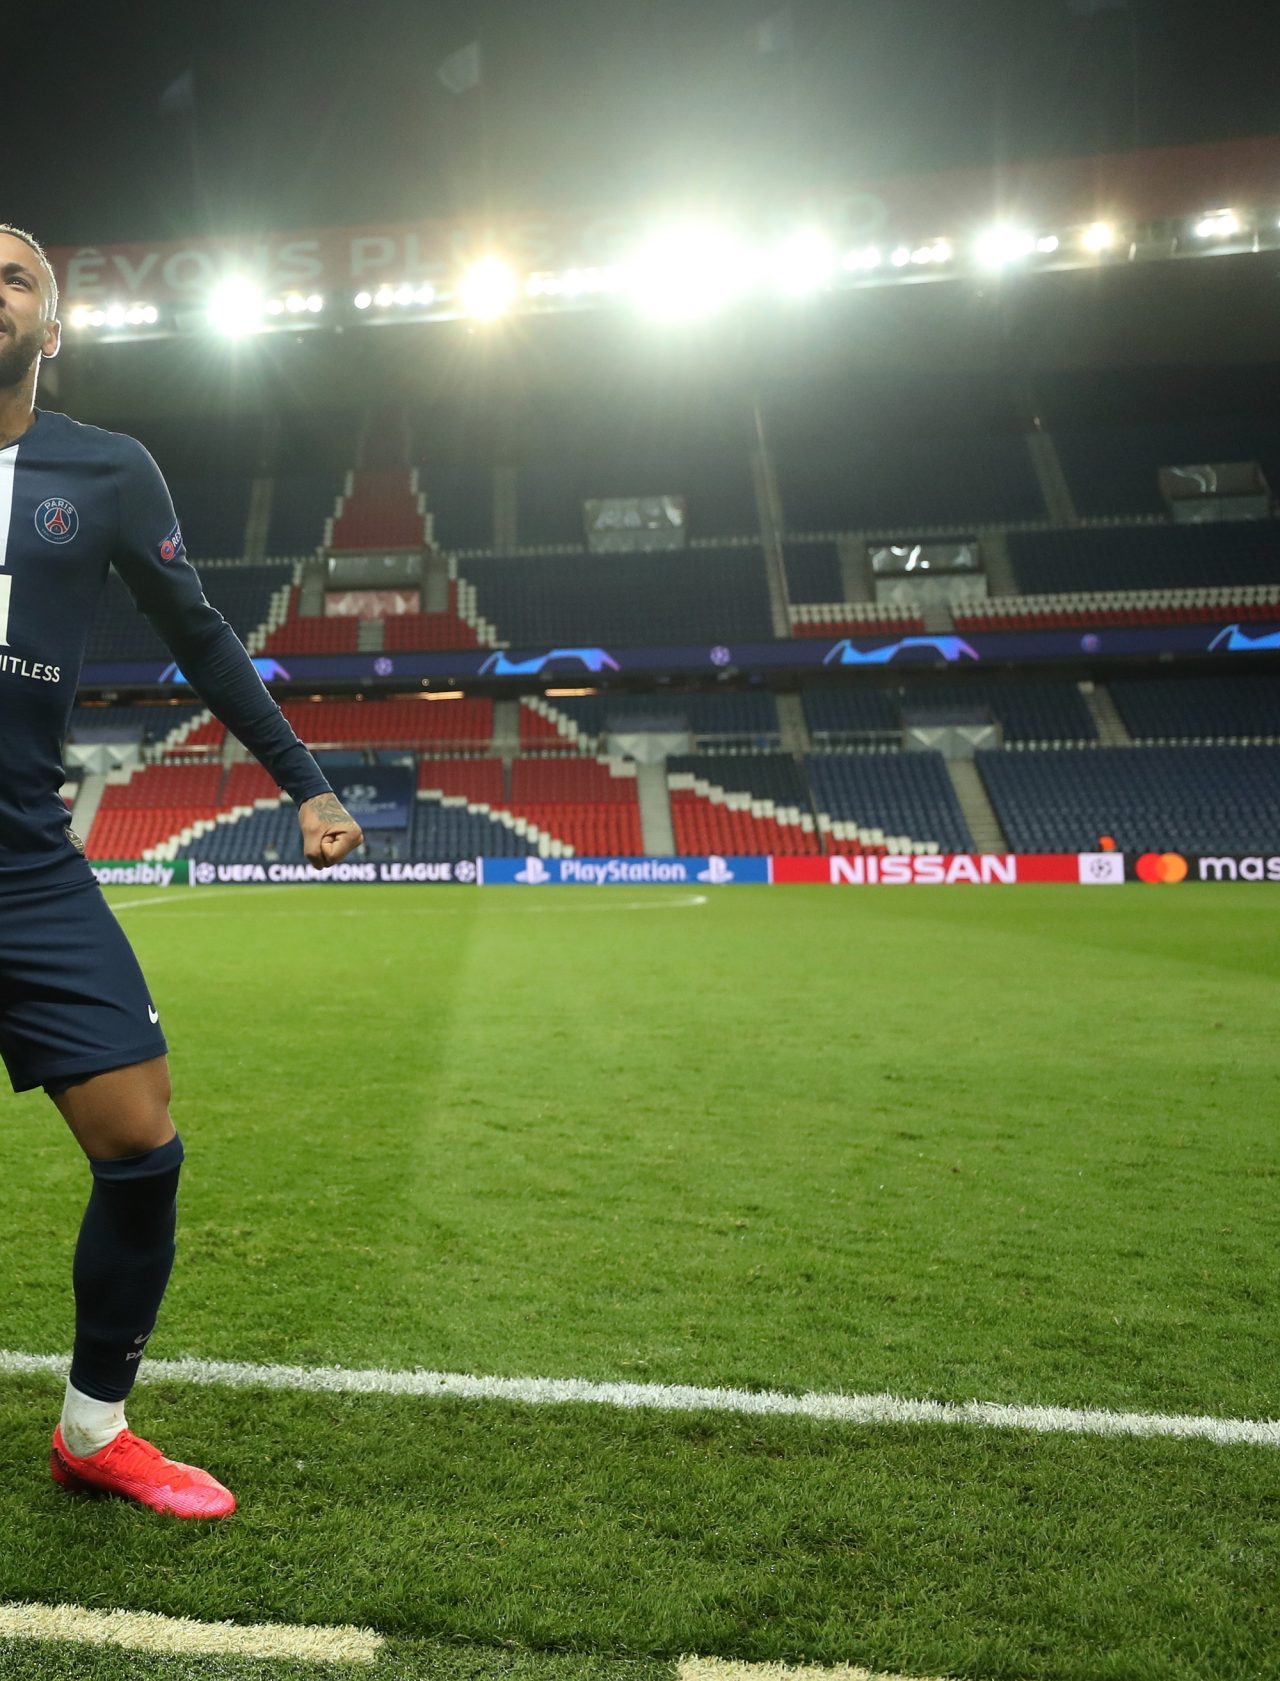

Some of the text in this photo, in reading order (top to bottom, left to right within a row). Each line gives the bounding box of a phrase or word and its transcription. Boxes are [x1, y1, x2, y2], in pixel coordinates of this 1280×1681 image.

[44, 500, 74, 515] PARIS
[217, 862, 450, 882] UEFA CHAMPIONS LEAGUE
[559, 857, 687, 884] PlayStation
[829, 855, 1017, 884] NISSAN
